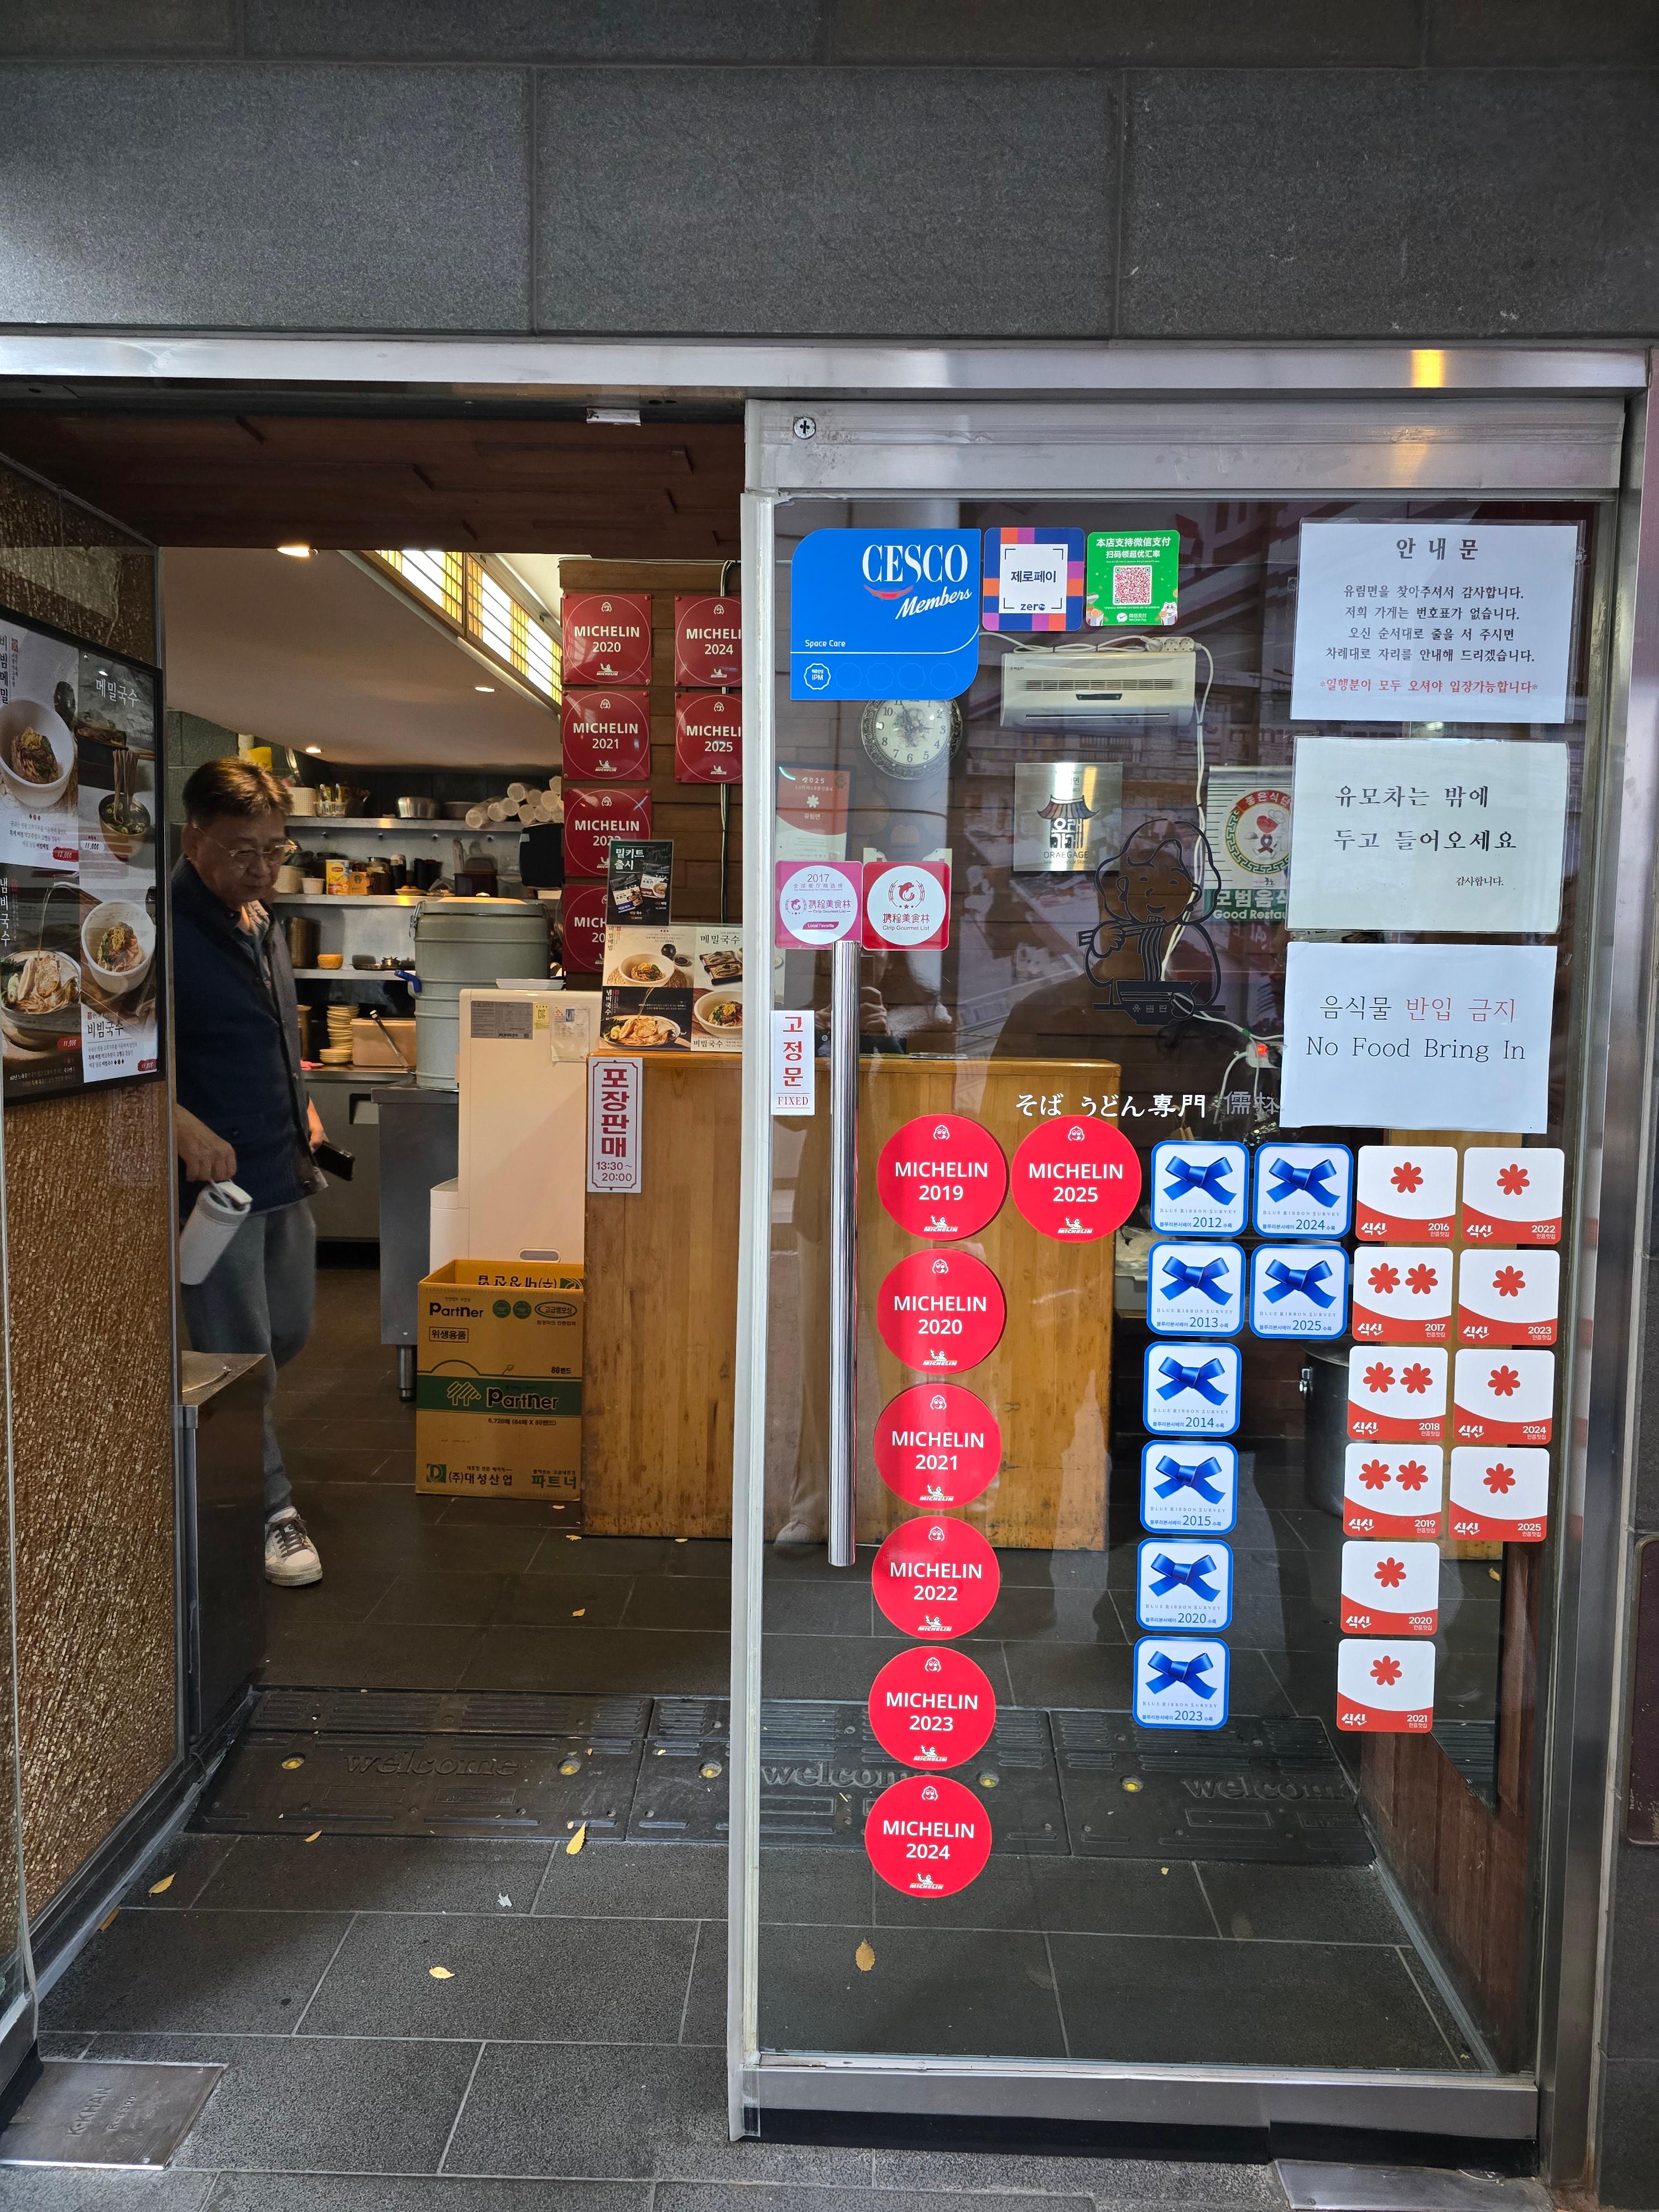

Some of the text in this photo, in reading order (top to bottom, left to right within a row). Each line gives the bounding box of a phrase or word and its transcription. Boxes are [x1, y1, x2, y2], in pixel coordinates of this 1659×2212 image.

[1096, 536, 1171, 547] 本店支持微信支付
[1106, 550, 1160, 559] 扫码领超优汇率
[862, 544, 968, 583] CESCO
[1010, 570, 1057, 584] 제로페이
[1344, 585, 1524, 600] 유림면을 찾아주셔서 감사합니다.
[895, 587, 972, 620] Members
[1345, 606, 1519, 620] 저희 가게는 번호표가 없습니다.
[574, 625, 640, 638] MICHELIN
[686, 628, 741, 640] MICHELI
[1348, 628, 1514, 641] 오신 순서대로 줄을 서 주시면
[592, 641, 621, 653] 2020
[705, 644, 733, 655] 2024
[805, 640, 827, 648] Space
[1326, 648, 1535, 662] 차례대로 자리를 안내해 드리겠습니다.
[96, 679, 142, 707] 메밀국수
[1379, 680, 1401, 691] 모두
[1408, 680, 1442, 693] 오셔야
[573, 722, 638, 734] MICHELIN
[686, 725, 741, 737] MICHELI
[592, 738, 619, 749] 2021
[705, 741, 733, 752] 2025
[1335, 785, 1489, 808] 유모차는 밖에
[575, 820, 640, 832] MICHELIN
[1333, 828, 1517, 852] 두고 들어오세요
[615, 848, 644, 858] 밀키트
[614, 860, 634, 870] 출시
[807, 874, 830, 883] 2017
[1455, 875, 1504, 886] 감사합니다.
[808, 900, 851, 909] 携程美食林
[0, 878, 11, 947] 냄비국수
[883, 914, 930, 924] 携程美食林
[1213, 910, 1286, 919] Good Restau
[574, 917, 606, 928] MICH
[701, 935, 740, 945] 메밀국수
[1319, 995, 1516, 1023] 음식물 반입 금지
[87, 1020, 124, 1039] 비빔국수
[783, 1016, 803, 1087] 고정문
[1306, 1036, 1526, 1063] No Food Bring In
[778, 1097, 808, 1105] FIXED
[1016, 1093, 1064, 1116] そば
[1081, 1094, 1145, 1118] うどん
[1148, 1094, 1206, 1118] 専門
[601, 1068, 629, 1157] 포장판매
[895, 1161, 988, 1178] MICHELIN
[1029, 1164, 1123, 1180] MICHELIN
[602, 1173, 632, 1181] 20:00
[919, 1185, 964, 1201] 2019
[1053, 1187, 1098, 1203] 2025
[1193, 1217, 1222, 1228] 2012
[1296, 1219, 1325, 1230] 2024
[1360, 1223, 1387, 1235] 식신
[1467, 1224, 1493, 1238] 식신
[429, 1302, 483, 1317] Partner
[894, 1296, 987, 1312] MICHELIN
[918, 1319, 963, 1335] 2020
[1190, 1317, 1218, 1328] 2013
[1293, 1320, 1322, 1331] 2025
[1357, 1323, 1384, 1335] 식신
[432, 1330, 466, 1340] 위생용품
[1463, 1326, 1489, 1339] 식신
[487, 1387, 558, 1410] Partner
[1186, 1417, 1214, 1428] 2014
[1353, 1421, 1379, 1434] 식신
[1458, 1425, 1484, 1438] 식신
[891, 1431, 985, 1448] MICHELIN
[915, 1454, 958, 1470] 2021
[532, 1475, 577, 1489] 파트너
[1183, 1515, 1211, 1526] 2015
[1348, 1518, 1374, 1531] 식신
[1454, 1522, 1480, 1535] 식신
[890, 1562, 982, 1579] MICHELIN
[914, 1585, 958, 1601] 2022
[1178, 1613, 1206, 1624] 2020
[1345, 1615, 1372, 1629] 식신
[886, 1692, 979, 1710] MICHELIN
[1175, 1710, 1203, 1721] 2023
[1341, 1713, 1367, 1725] 식신
[910, 1715, 953, 1731] 2023
[344, 1751, 519, 1776] welcome
[761, 1759, 931, 1787] welcom
[883, 1820, 975, 1839] MICHELIN
[906, 1844, 950, 1860] 2024
